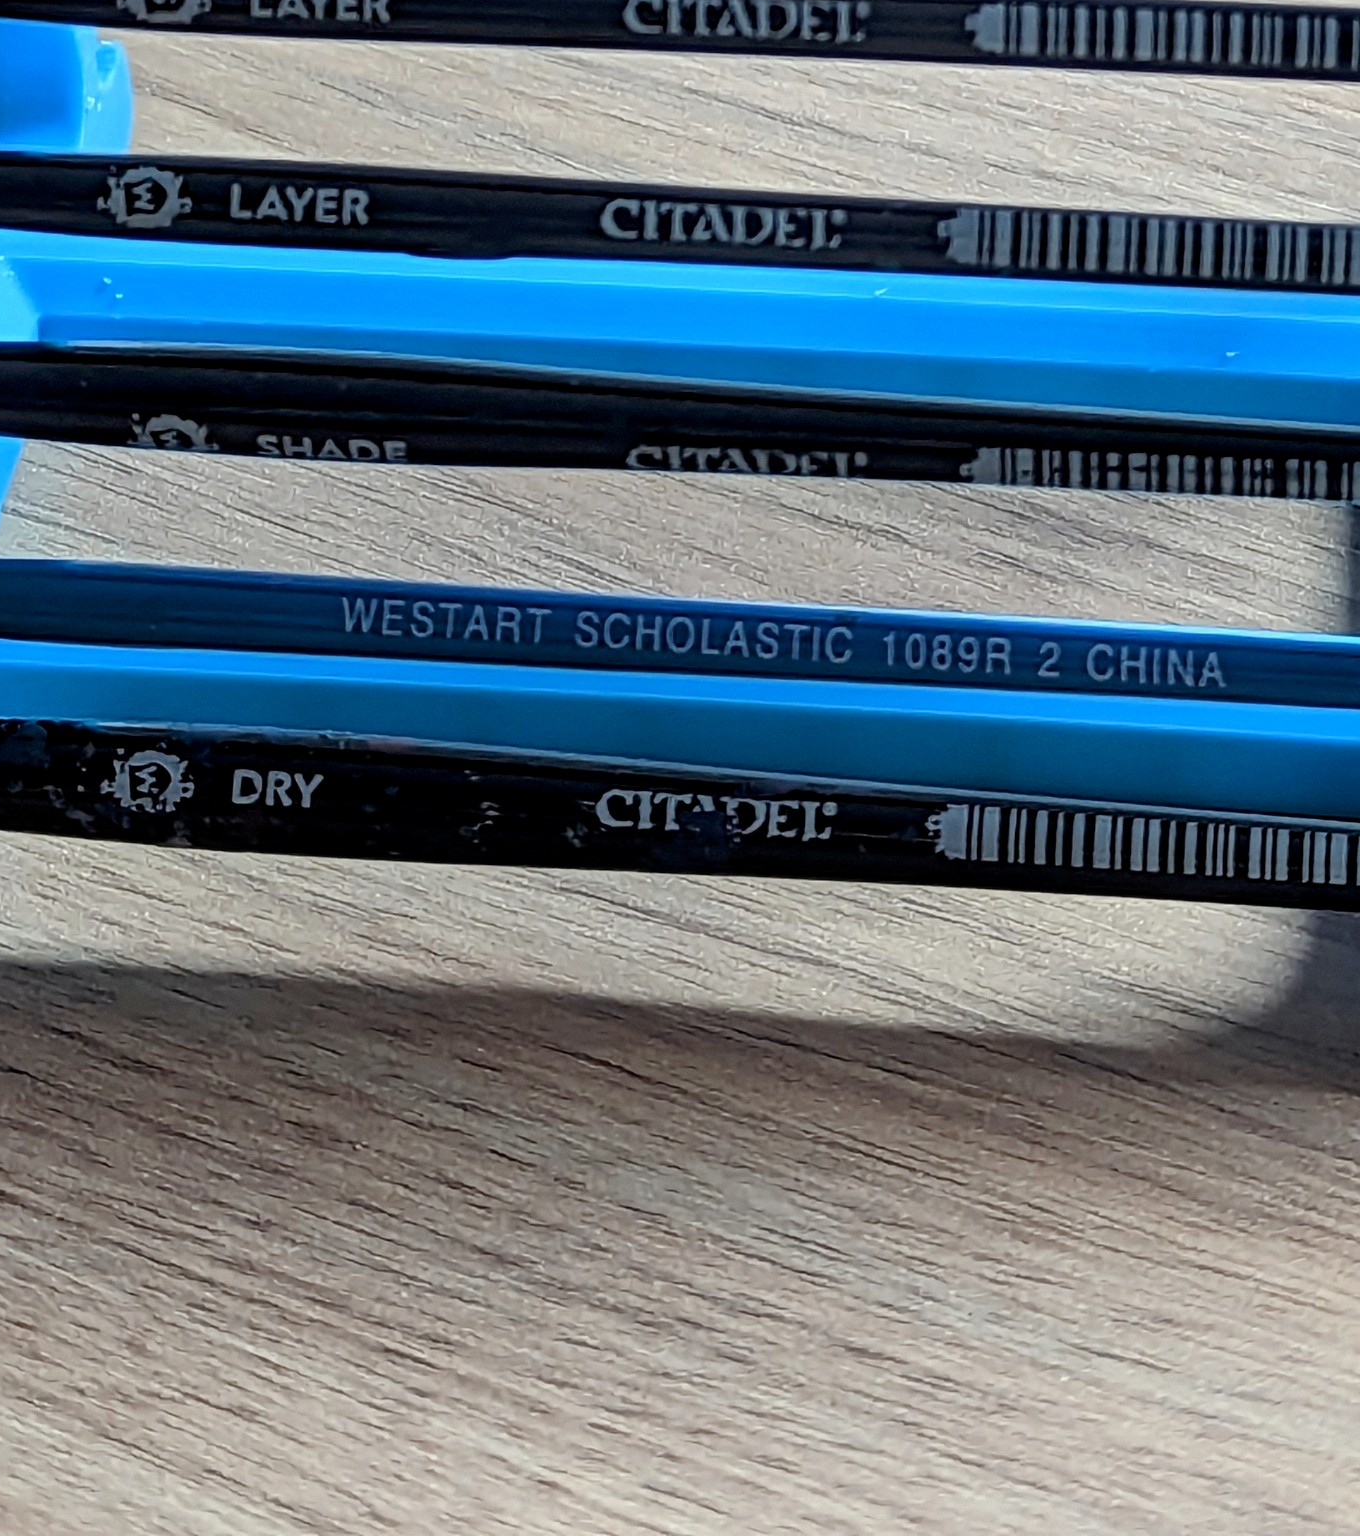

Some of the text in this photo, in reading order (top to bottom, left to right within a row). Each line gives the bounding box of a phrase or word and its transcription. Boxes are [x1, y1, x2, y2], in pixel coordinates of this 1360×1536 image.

[229, 183, 842, 250] LAYER CITADEL
[256, 434, 408, 462] SHADE
[342, 597, 1227, 688] WESTART SCHOLASTIC 1089R 2 CHINA
[232, 769, 324, 808] DRY
